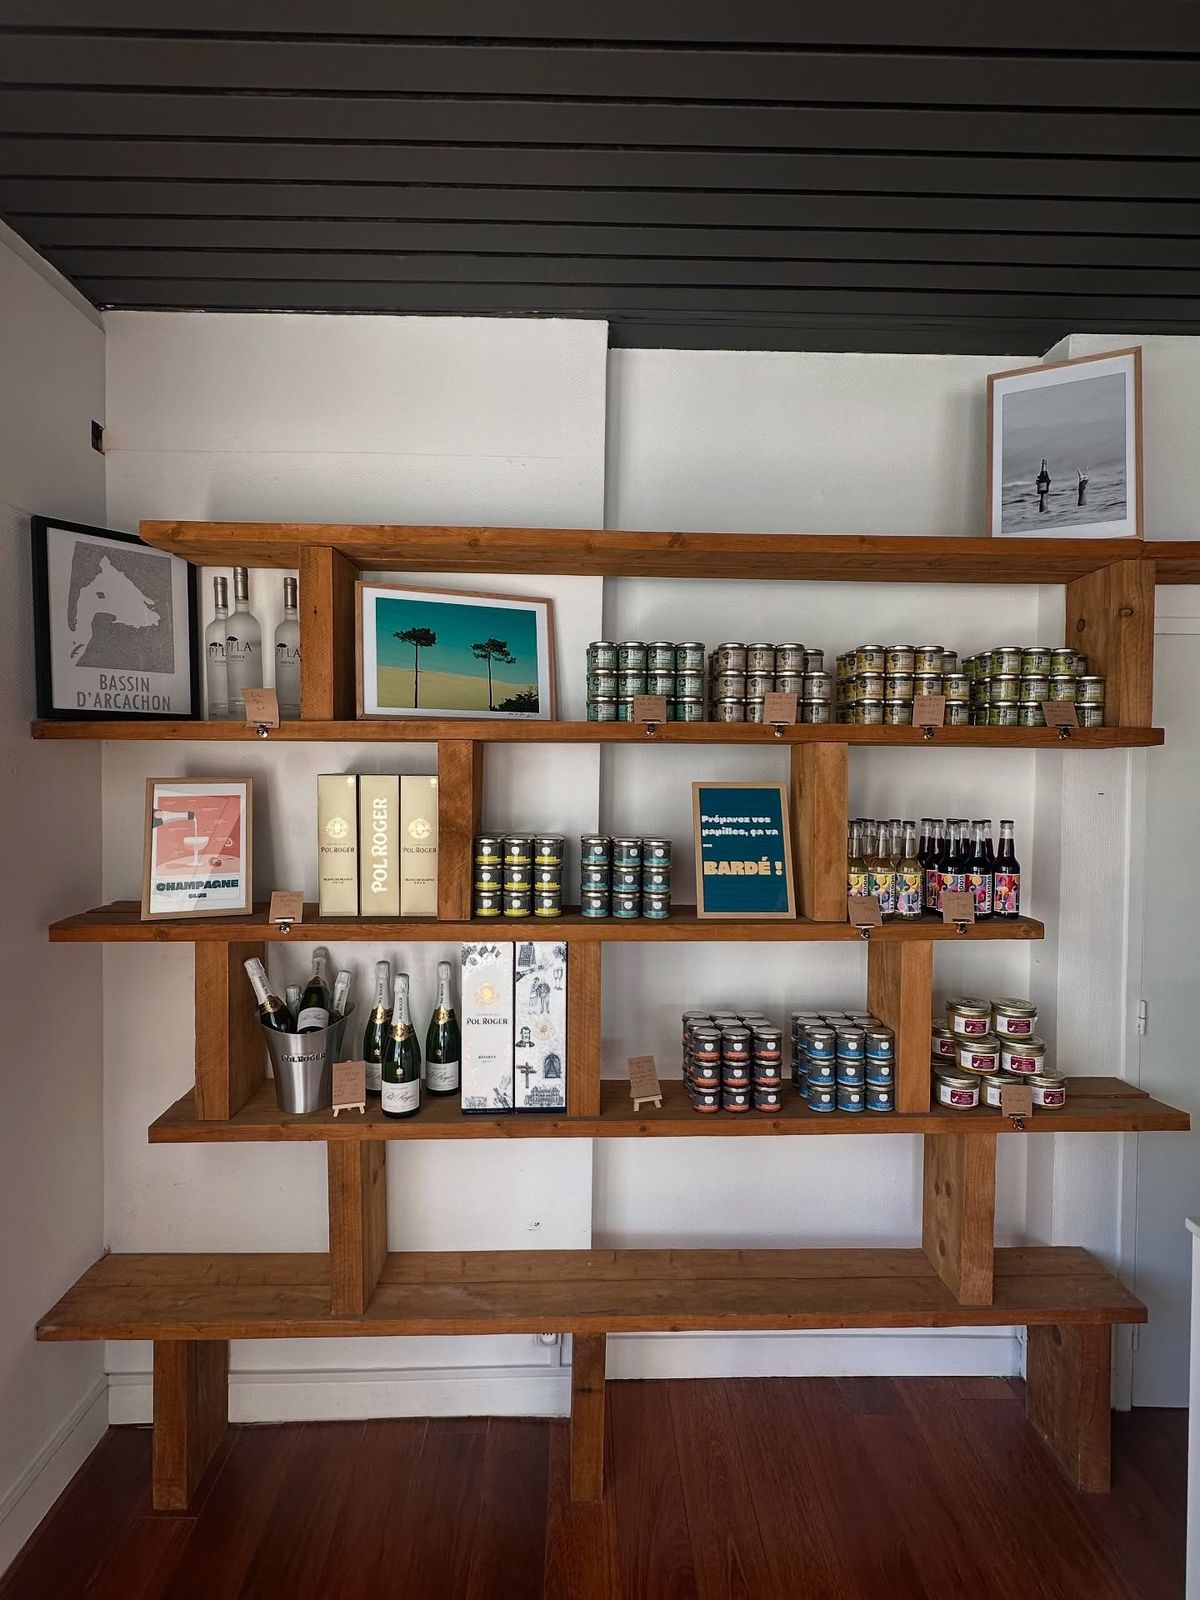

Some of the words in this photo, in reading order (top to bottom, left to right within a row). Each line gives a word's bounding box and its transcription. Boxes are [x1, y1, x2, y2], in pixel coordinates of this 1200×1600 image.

[100, 674, 150, 692] BASSIN
[76, 691, 170, 711] D'ARCACHON
[372, 798, 388, 857] ROGER
[702, 814, 751, 824] Préparez
[702, 826, 749, 836] papilles,
[750, 828, 764, 836] ça
[704, 856, 771, 875] BARDÉ
[774, 861, 782, 876] !
[156, 879, 239, 892] CHAMPAGNE
[372, 858, 388, 894] POL
